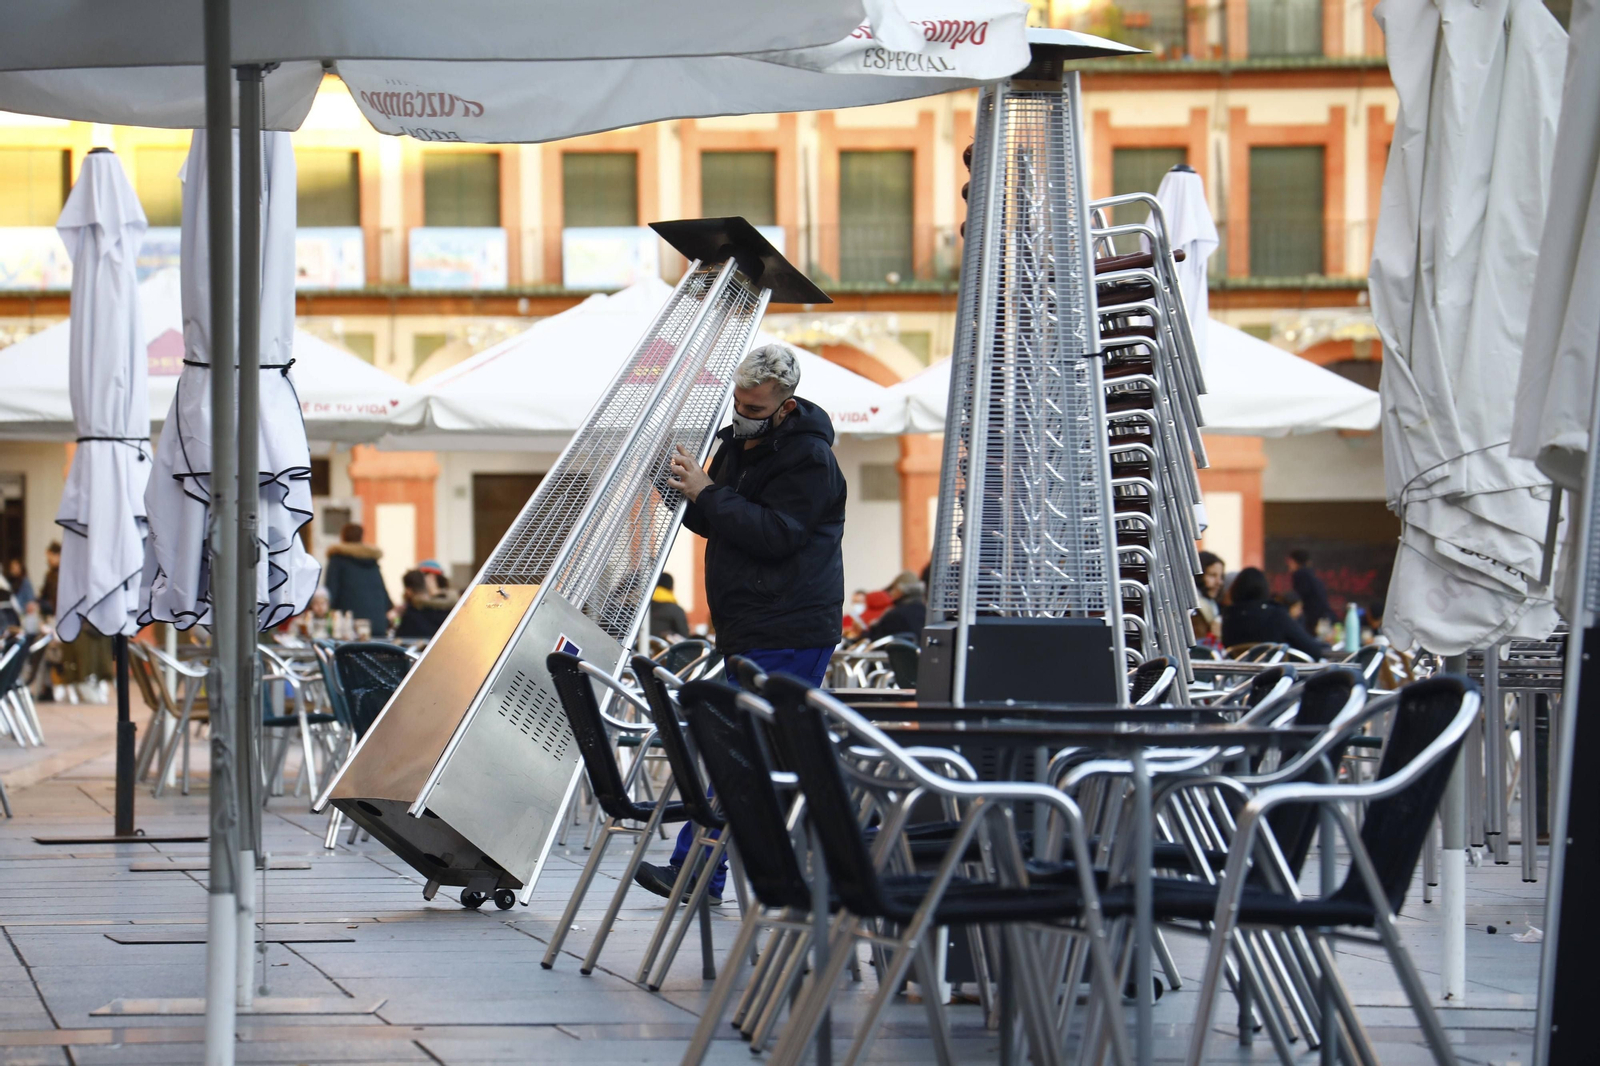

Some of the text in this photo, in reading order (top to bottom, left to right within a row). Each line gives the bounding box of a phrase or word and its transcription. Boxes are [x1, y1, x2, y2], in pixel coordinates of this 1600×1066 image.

[863, 47, 956, 73] ESPECIAL
[357, 405, 388, 416] VIDA
[838, 411, 869, 424] VIDA
